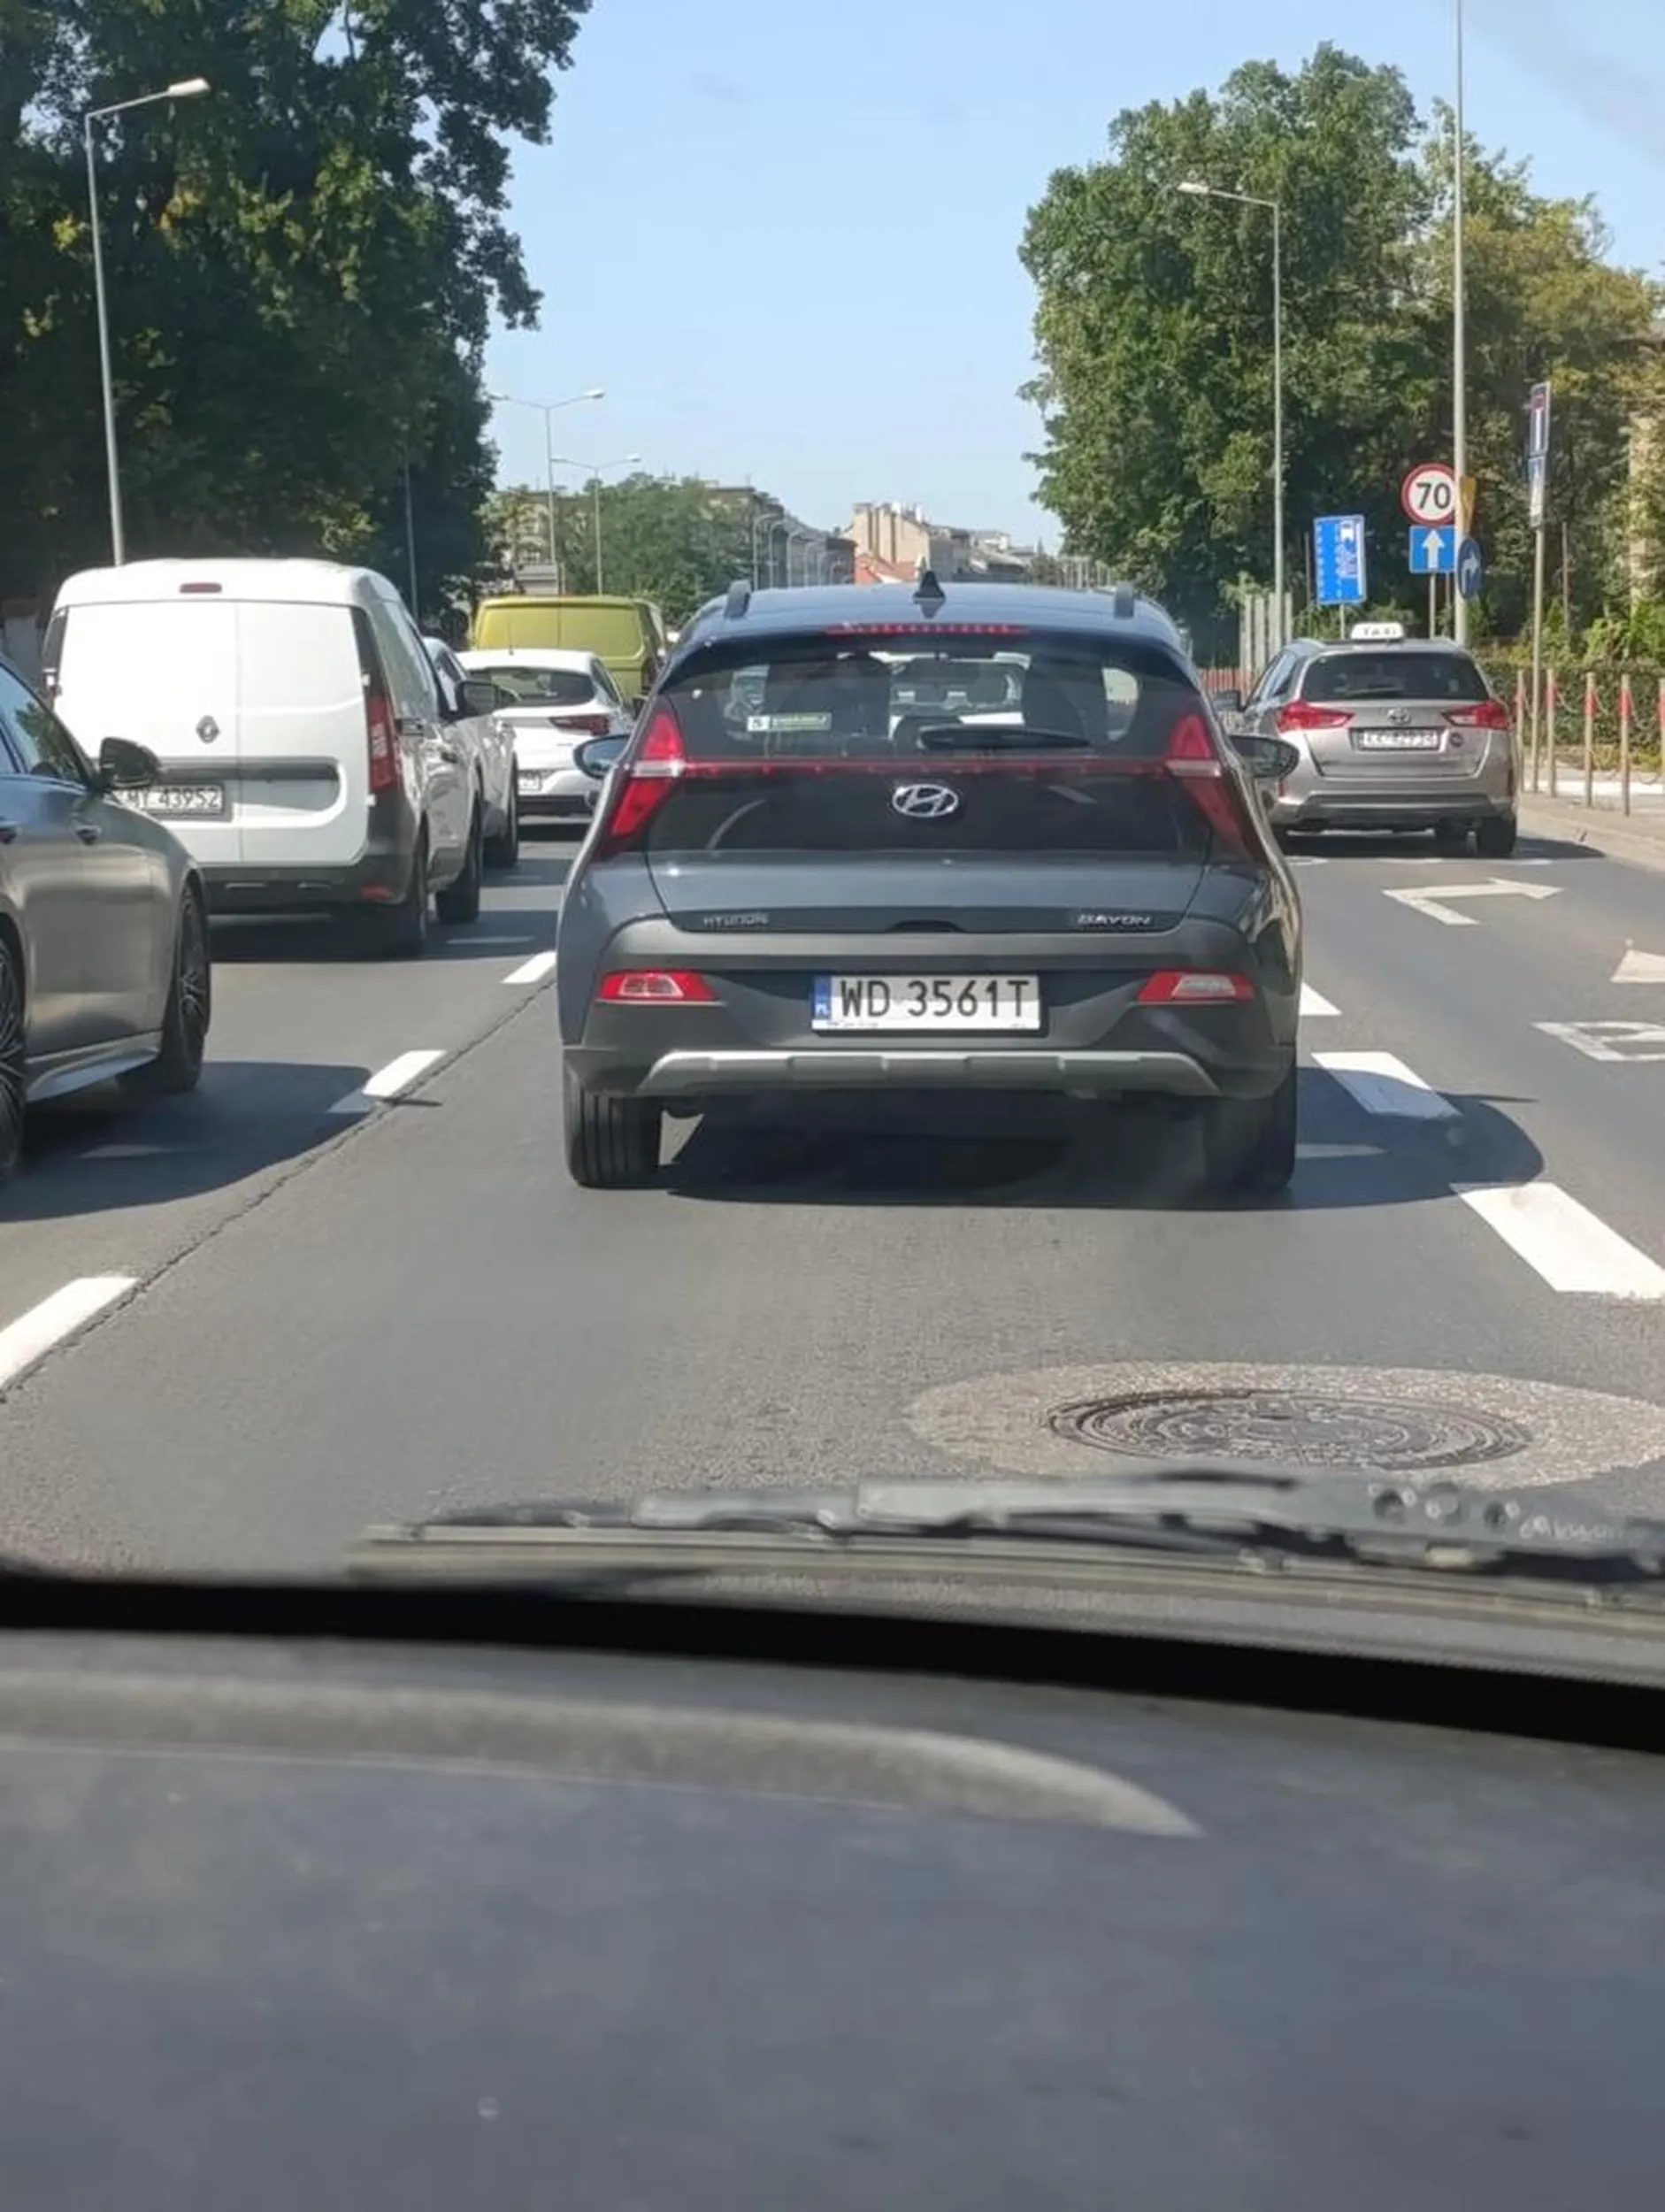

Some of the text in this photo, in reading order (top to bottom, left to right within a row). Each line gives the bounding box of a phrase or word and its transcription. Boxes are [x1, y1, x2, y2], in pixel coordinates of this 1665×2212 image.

[1416, 482, 1451, 510] 70
[840, 979, 1030, 1018] WD 3561T
